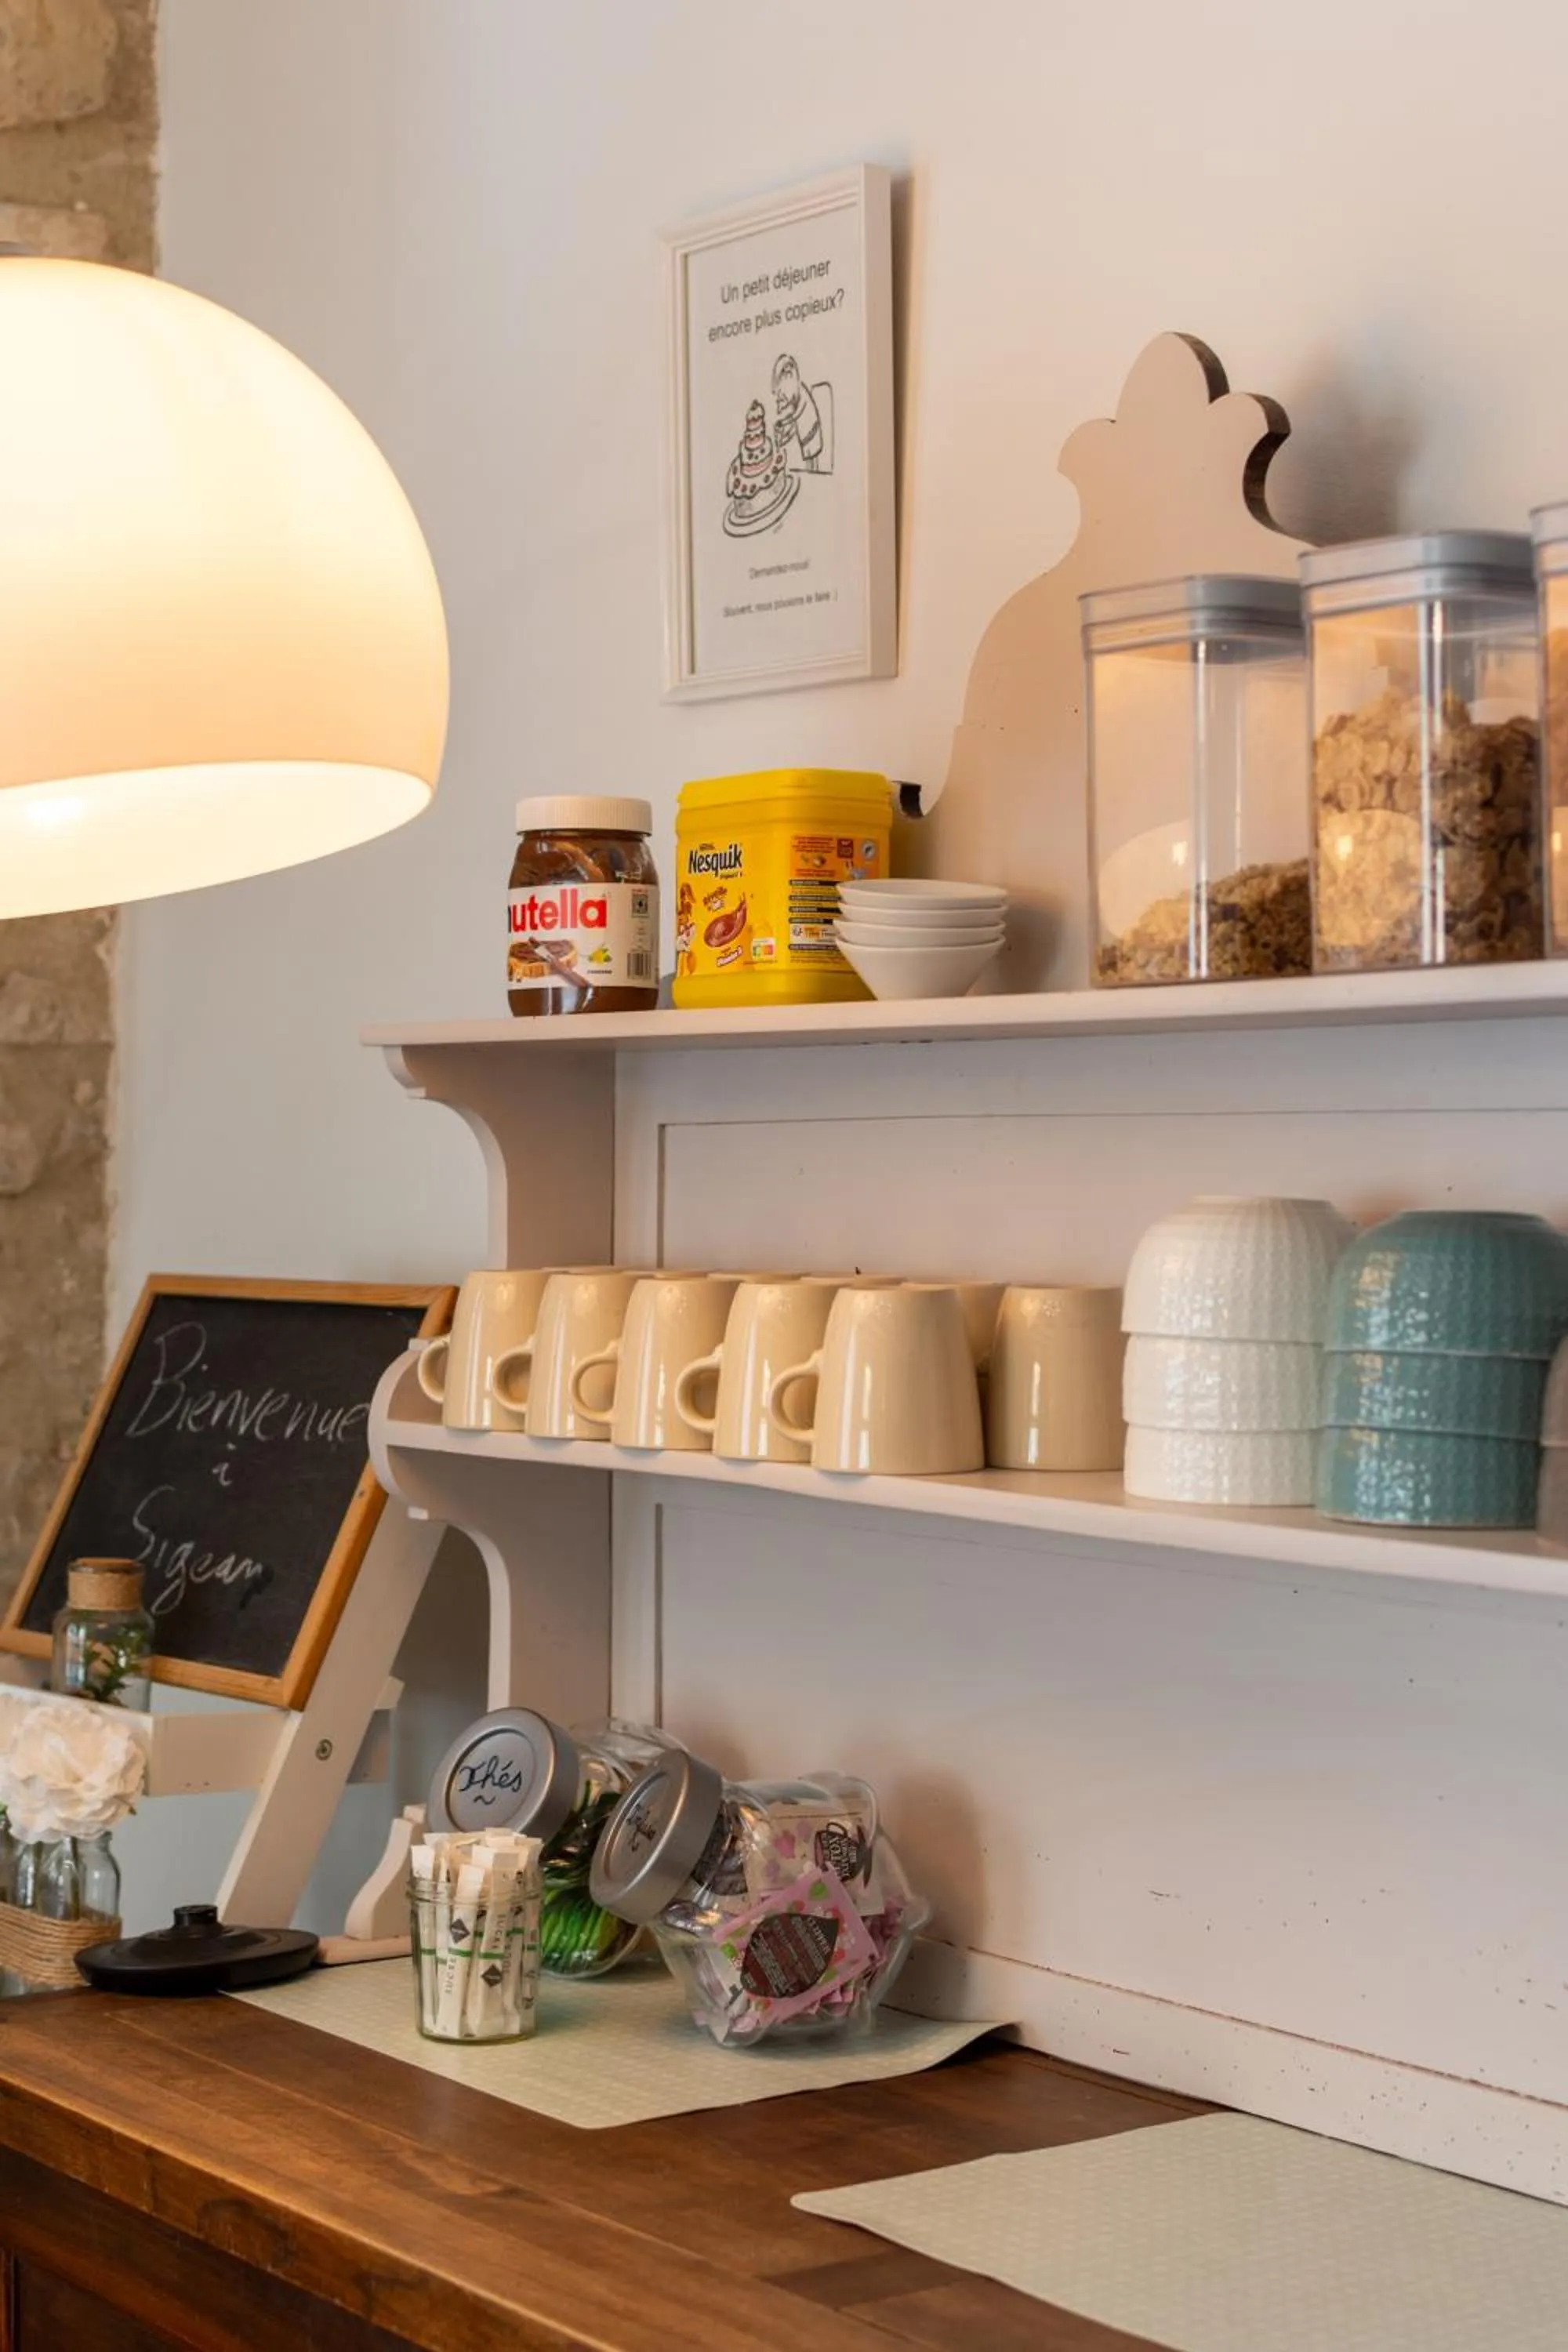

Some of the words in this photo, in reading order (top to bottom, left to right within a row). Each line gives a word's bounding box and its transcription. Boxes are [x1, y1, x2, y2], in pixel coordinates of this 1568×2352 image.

[720, 284, 739, 304] Un
[742, 274, 770, 303] petit
[772, 260, 831, 292] déjeuner
[708, 317, 753, 343] encore
[755, 308, 782, 334] plus
[785, 287, 845, 323] copieux?
[688, 843, 743, 878] Nesquik
[507, 887, 608, 933] utella
[125, 1321, 371, 1443] Bienvenue
[132, 1485, 263, 1615] Sigean
[459, 1755, 522, 1793] Thés
